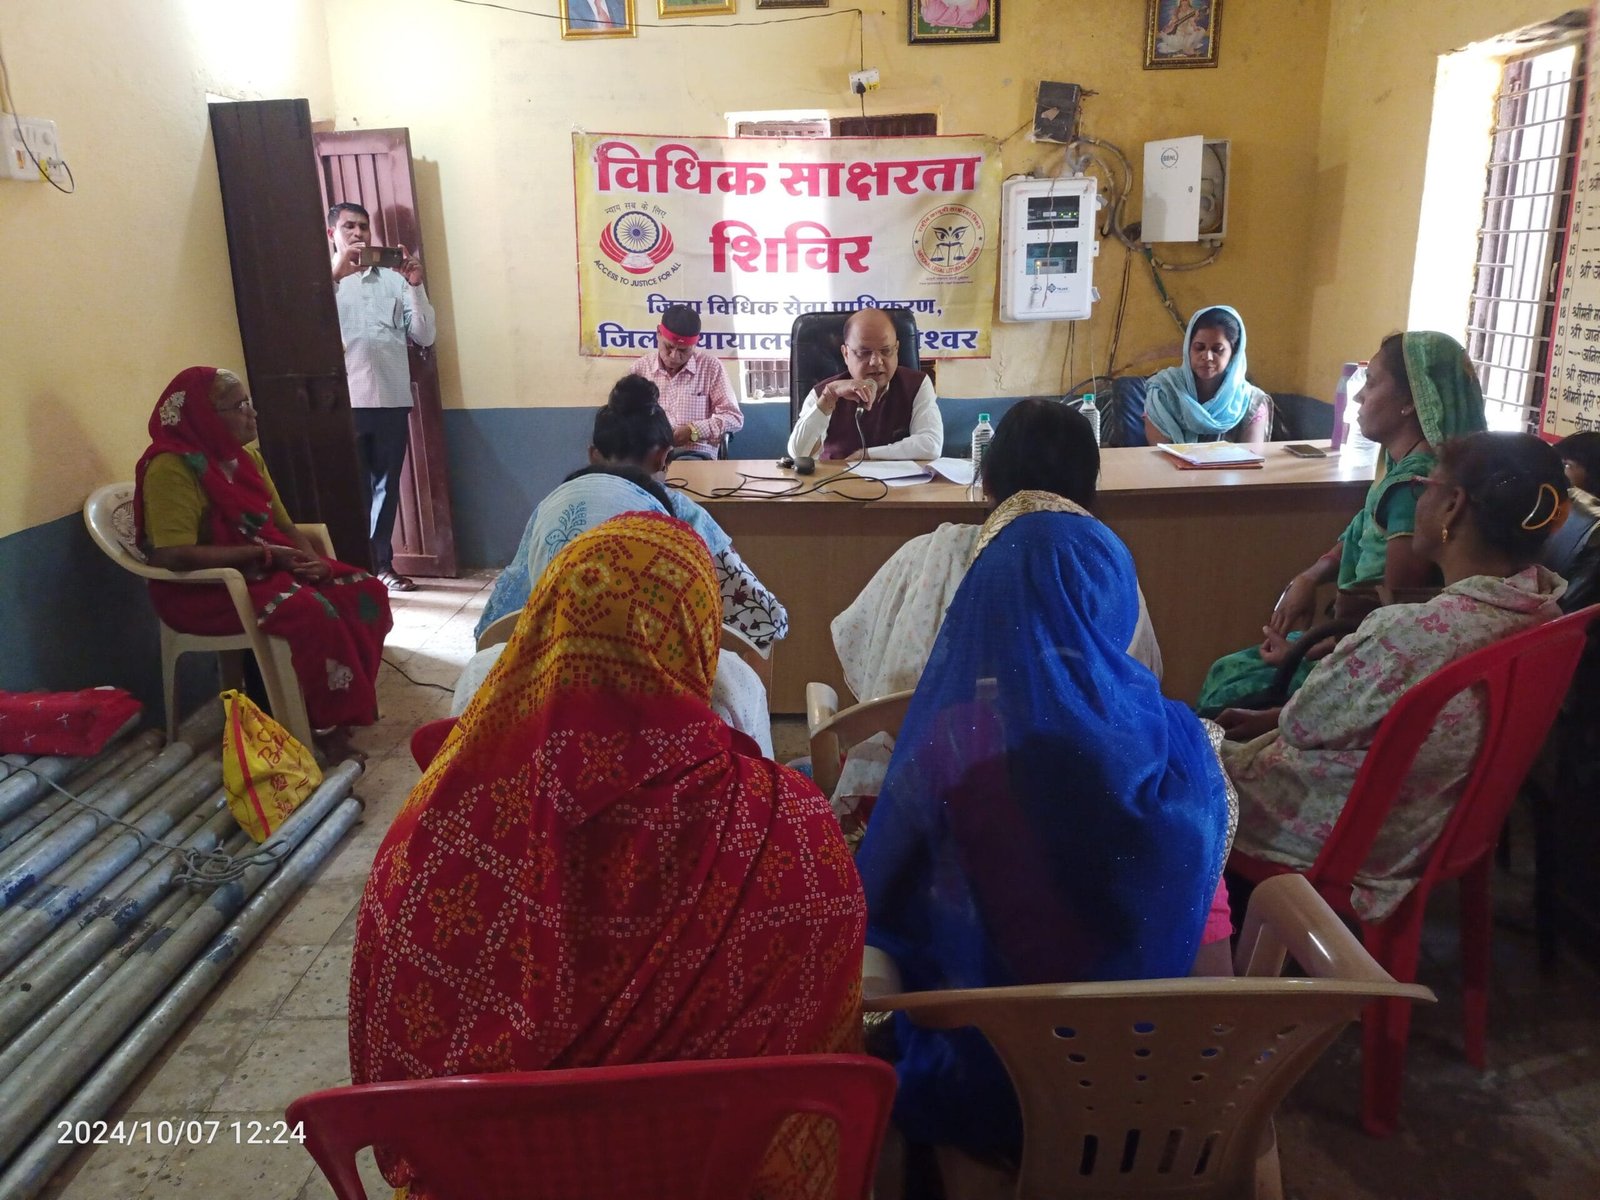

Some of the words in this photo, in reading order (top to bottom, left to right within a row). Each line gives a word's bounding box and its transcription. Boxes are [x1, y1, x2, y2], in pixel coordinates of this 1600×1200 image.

[593, 142, 768, 196] विधिक
[779, 155, 981, 201] साक्षरता
[709, 219, 872, 273] शिविर
[594, 260, 619, 281] ACCESS
[620, 277, 629, 285] TO
[631, 277, 657, 287] JUSTICE
[658, 271, 672, 282] FOR
[671, 262, 681, 273] ALL
[1562, 287, 1570, 299] 17
[707, 294, 778, 315] विधिक
[1554, 344, 1563, 357] 20
[1552, 365, 1560, 378] 21
[1549, 387, 1558, 400] 22
[1546, 410, 1556, 424] 23
